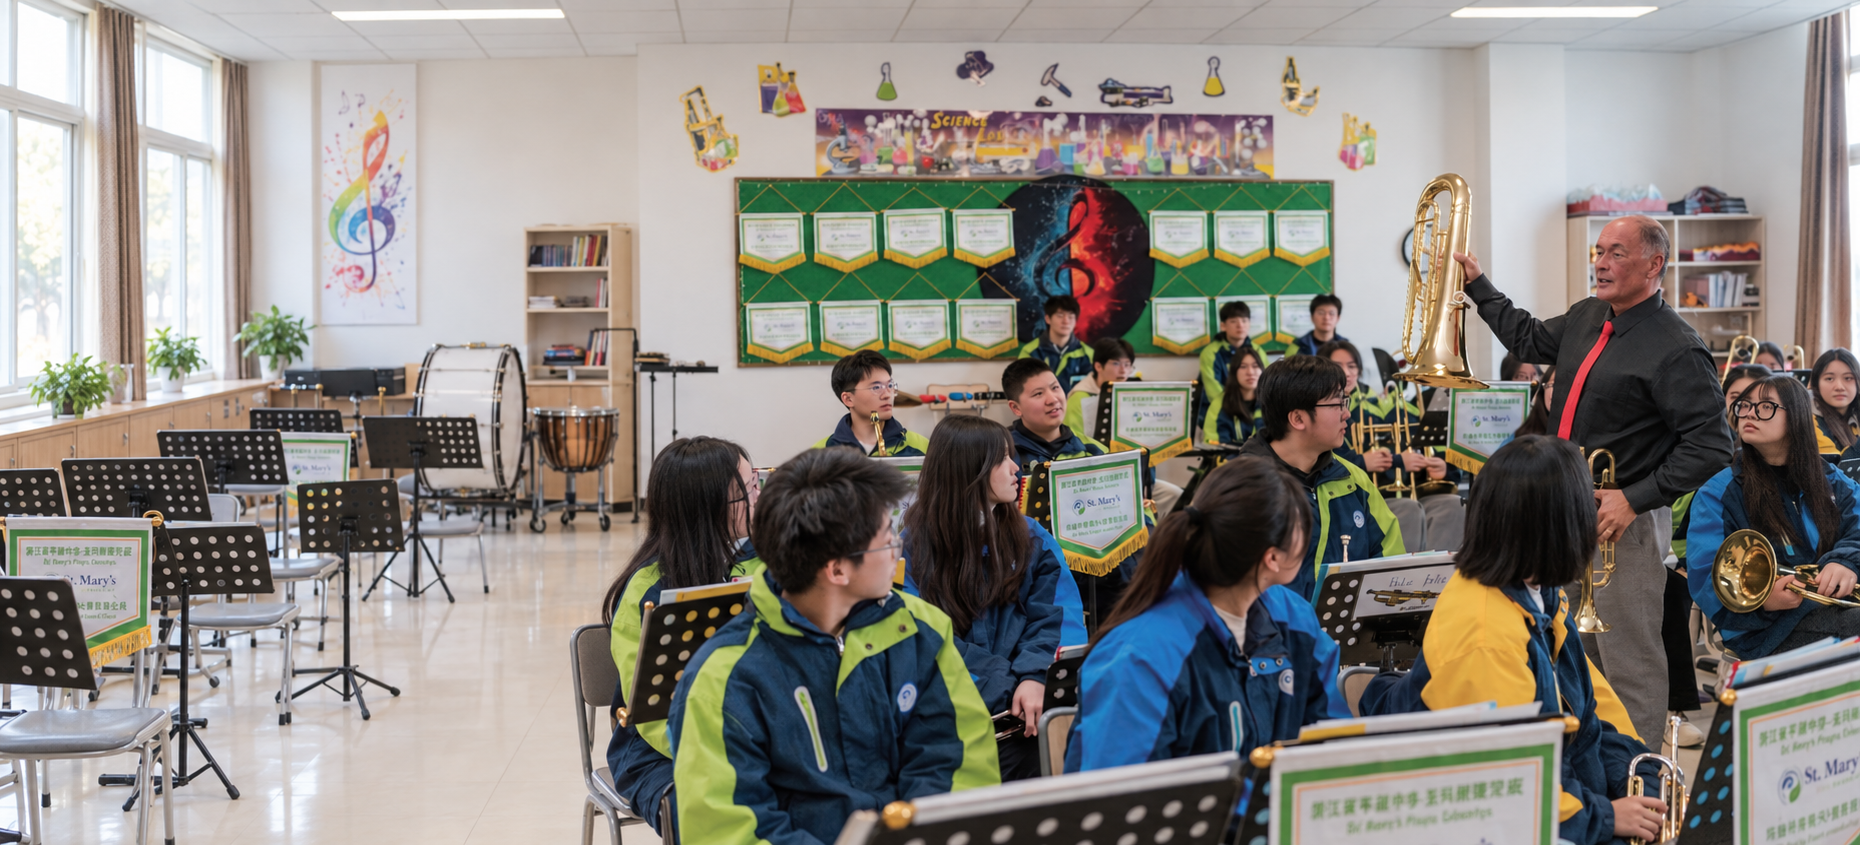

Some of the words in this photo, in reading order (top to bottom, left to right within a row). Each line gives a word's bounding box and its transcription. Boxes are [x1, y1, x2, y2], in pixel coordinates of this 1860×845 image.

[1087, 499, 1097, 507] St.
[1098, 494, 1121, 506] Mary's
[79, 574, 117, 588] Mary's
[1804, 765, 1821, 785] St.
[1824, 755, 1860, 779] Mary
